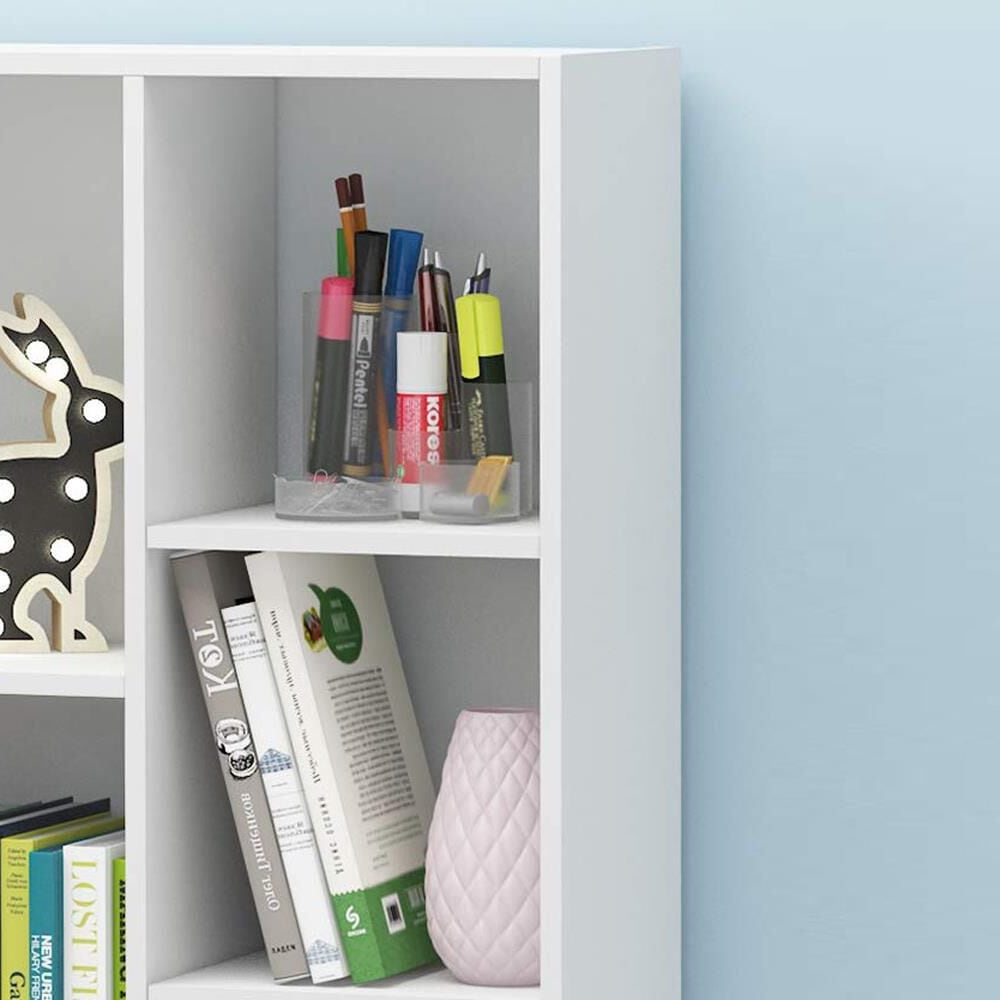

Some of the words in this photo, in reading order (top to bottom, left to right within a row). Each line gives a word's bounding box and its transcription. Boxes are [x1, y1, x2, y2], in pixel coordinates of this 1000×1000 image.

[355, 359, 370, 409] Pentel
[71, 860, 99, 953] LOST
[32, 935, 40, 972] HILARY
[40, 935, 52, 969] NEW
